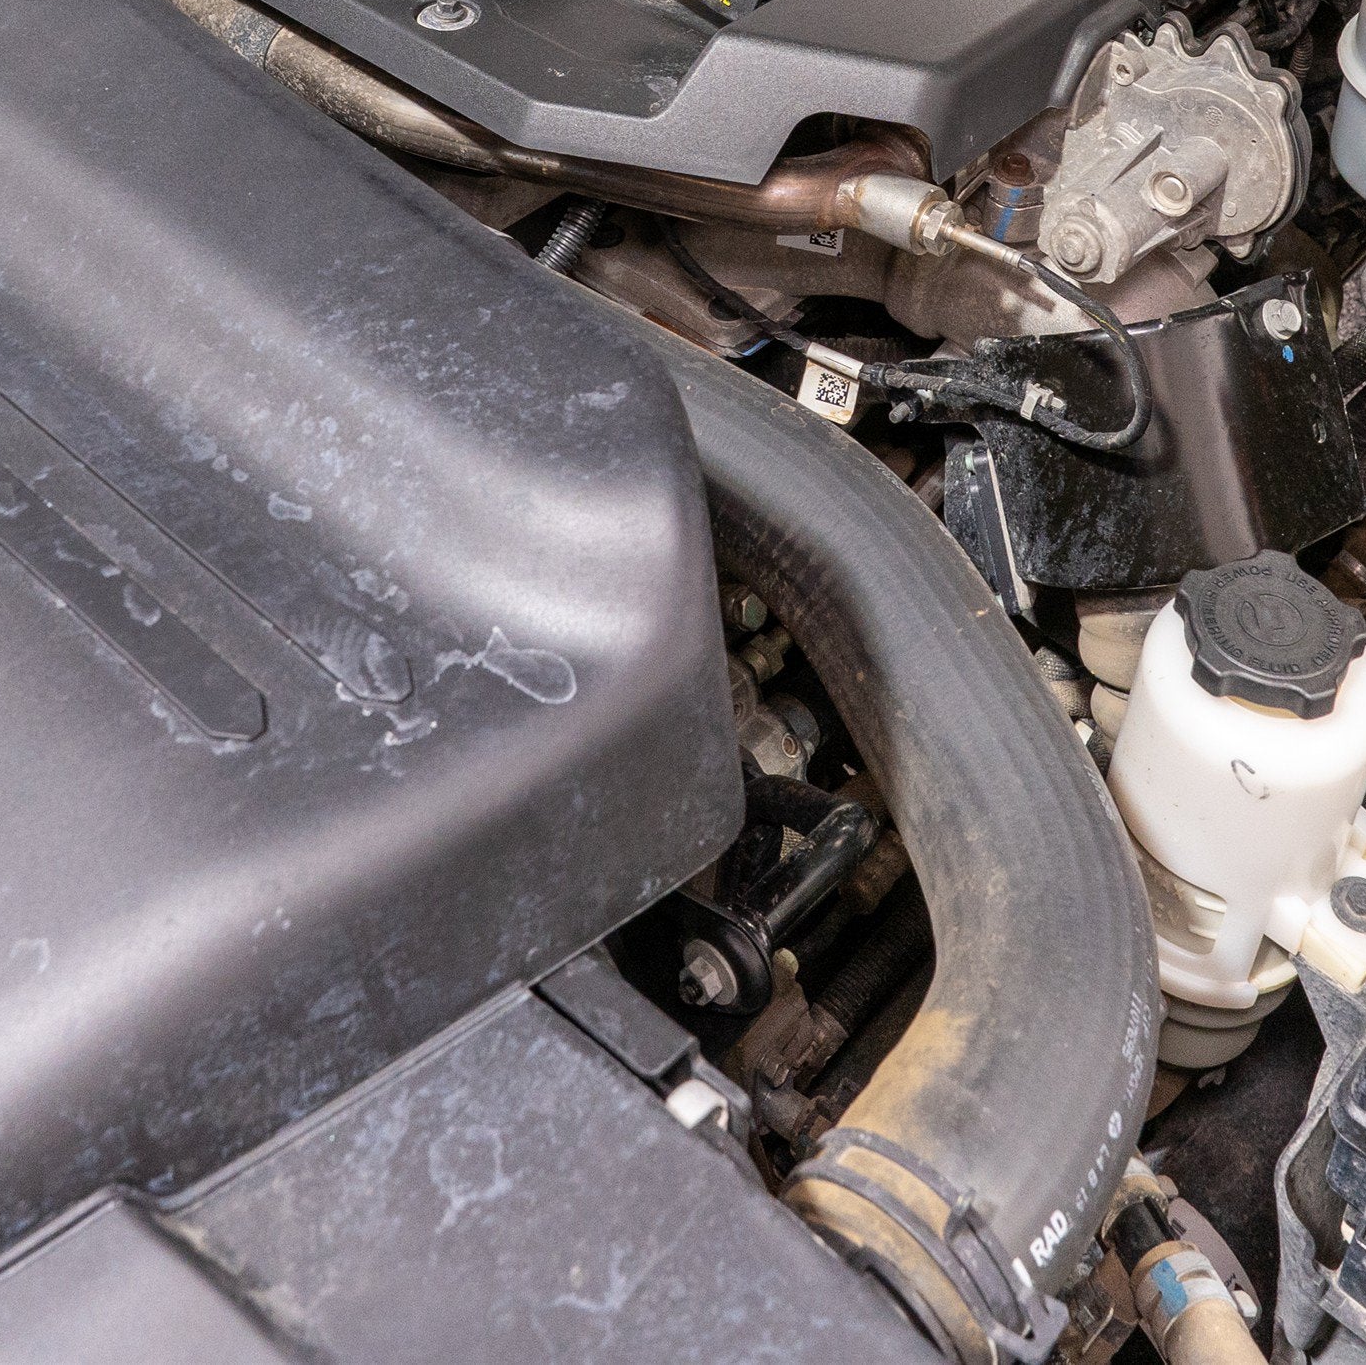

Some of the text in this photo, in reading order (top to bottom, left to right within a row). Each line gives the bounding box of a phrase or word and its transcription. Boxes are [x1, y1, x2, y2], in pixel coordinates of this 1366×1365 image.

[1212, 565, 1273, 590] POWER
[1285, 571, 1318, 595] USE
[1204, 589, 1244, 661] STEERING
[1248, 656, 1301, 674] FLUID
[1030, 1209, 1068, 1267] RAD
